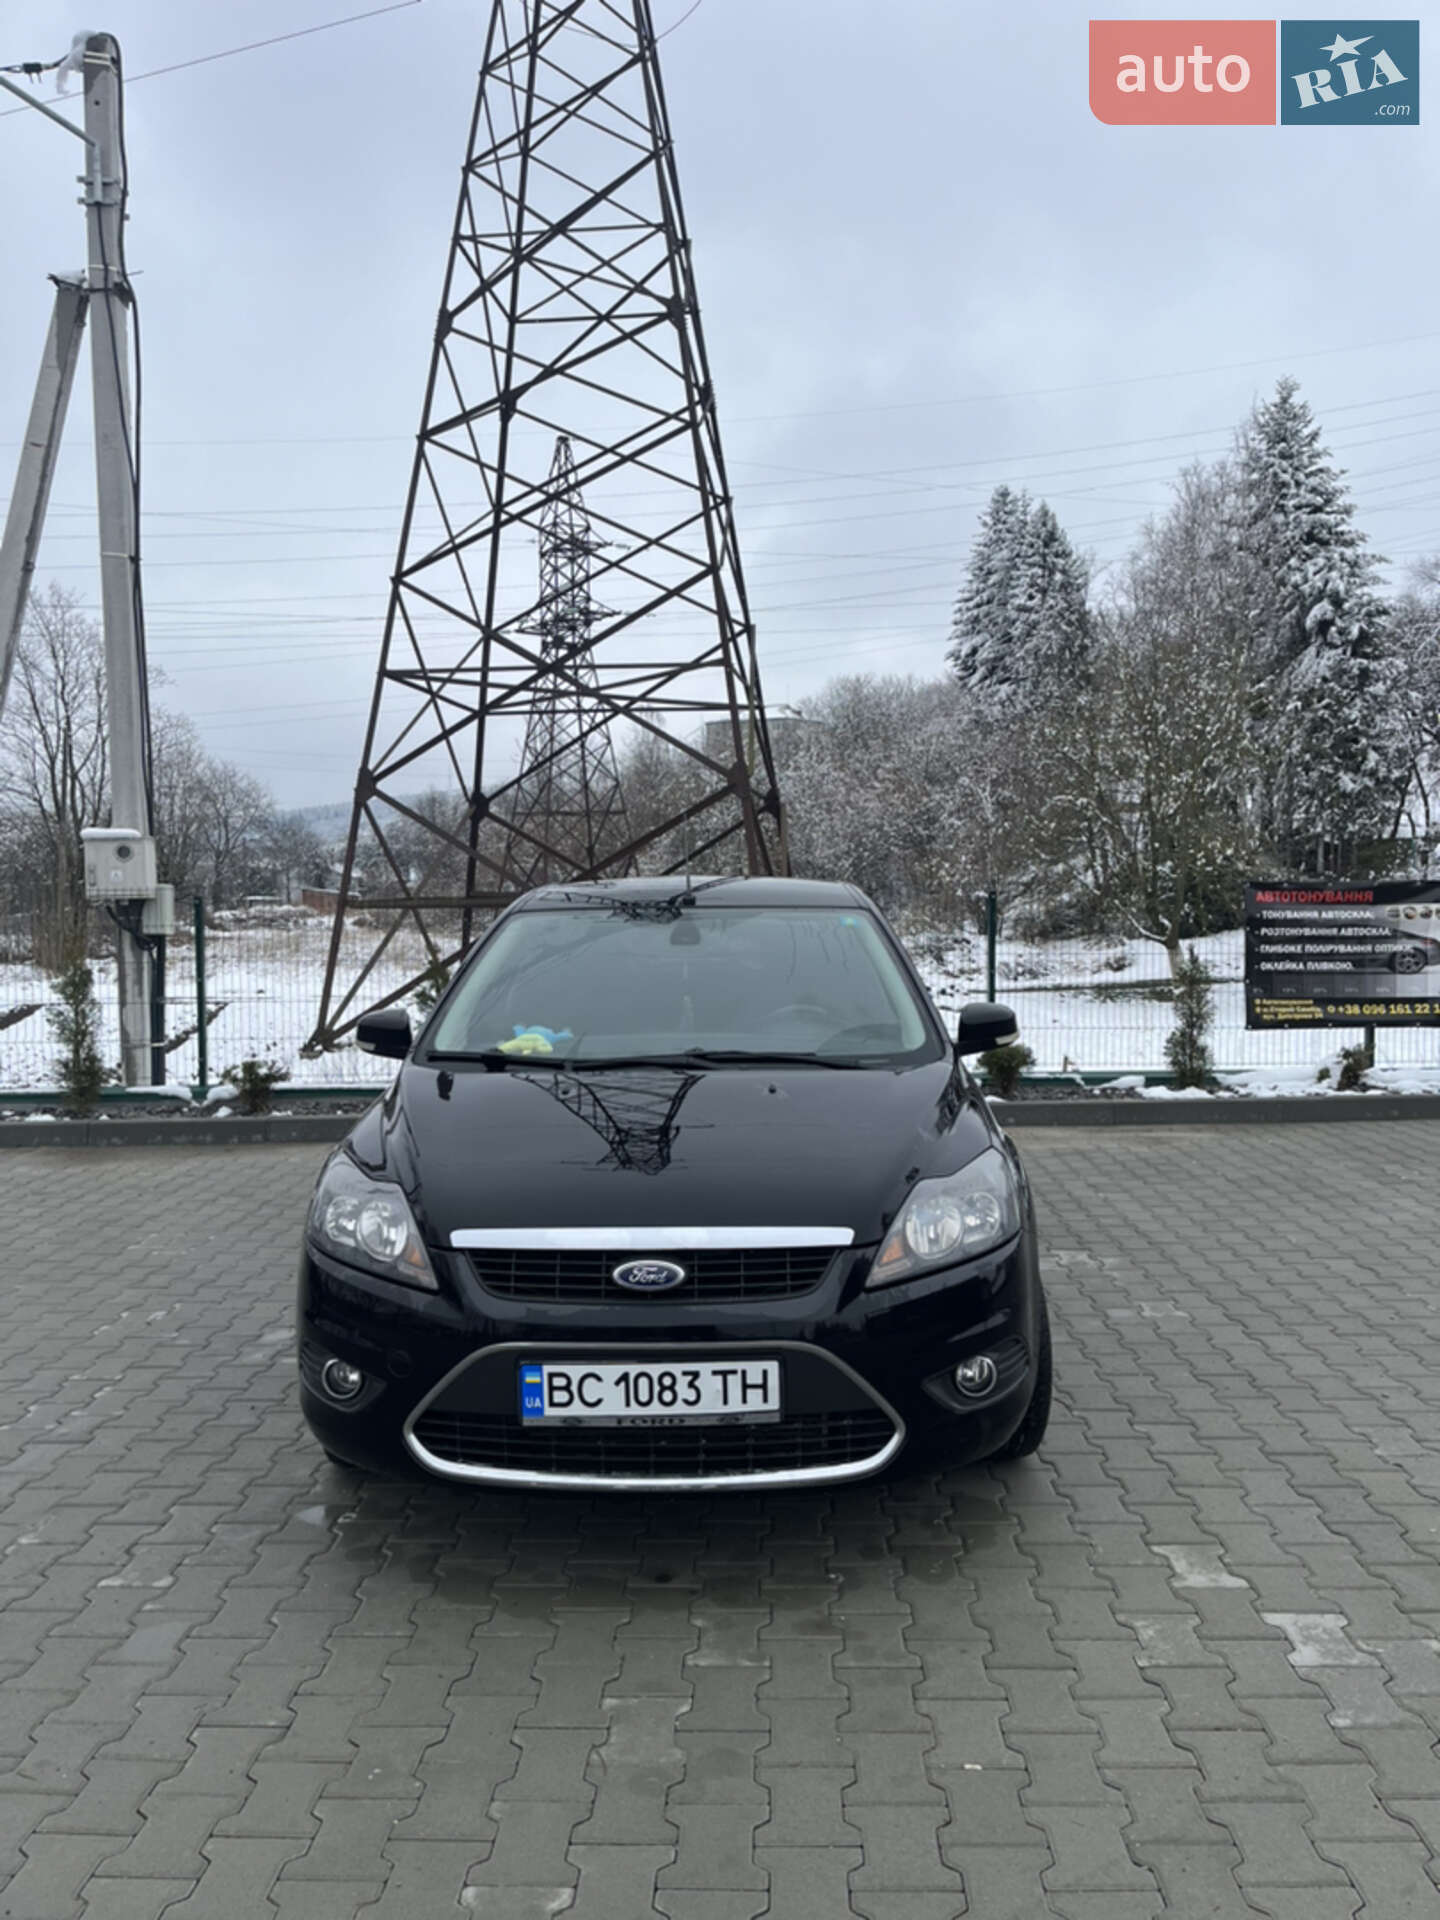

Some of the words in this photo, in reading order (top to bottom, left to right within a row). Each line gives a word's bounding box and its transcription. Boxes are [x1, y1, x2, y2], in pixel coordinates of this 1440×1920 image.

[1255, 890, 1374, 904] АВТОТОНУВАННЯ
[628, 1266, 668, 1283] Ford
[547, 1372, 604, 1408] BC
[614, 1370, 701, 1408] 1083
[711, 1369, 768, 1406] TH
[525, 1397, 542, 1409] UA
